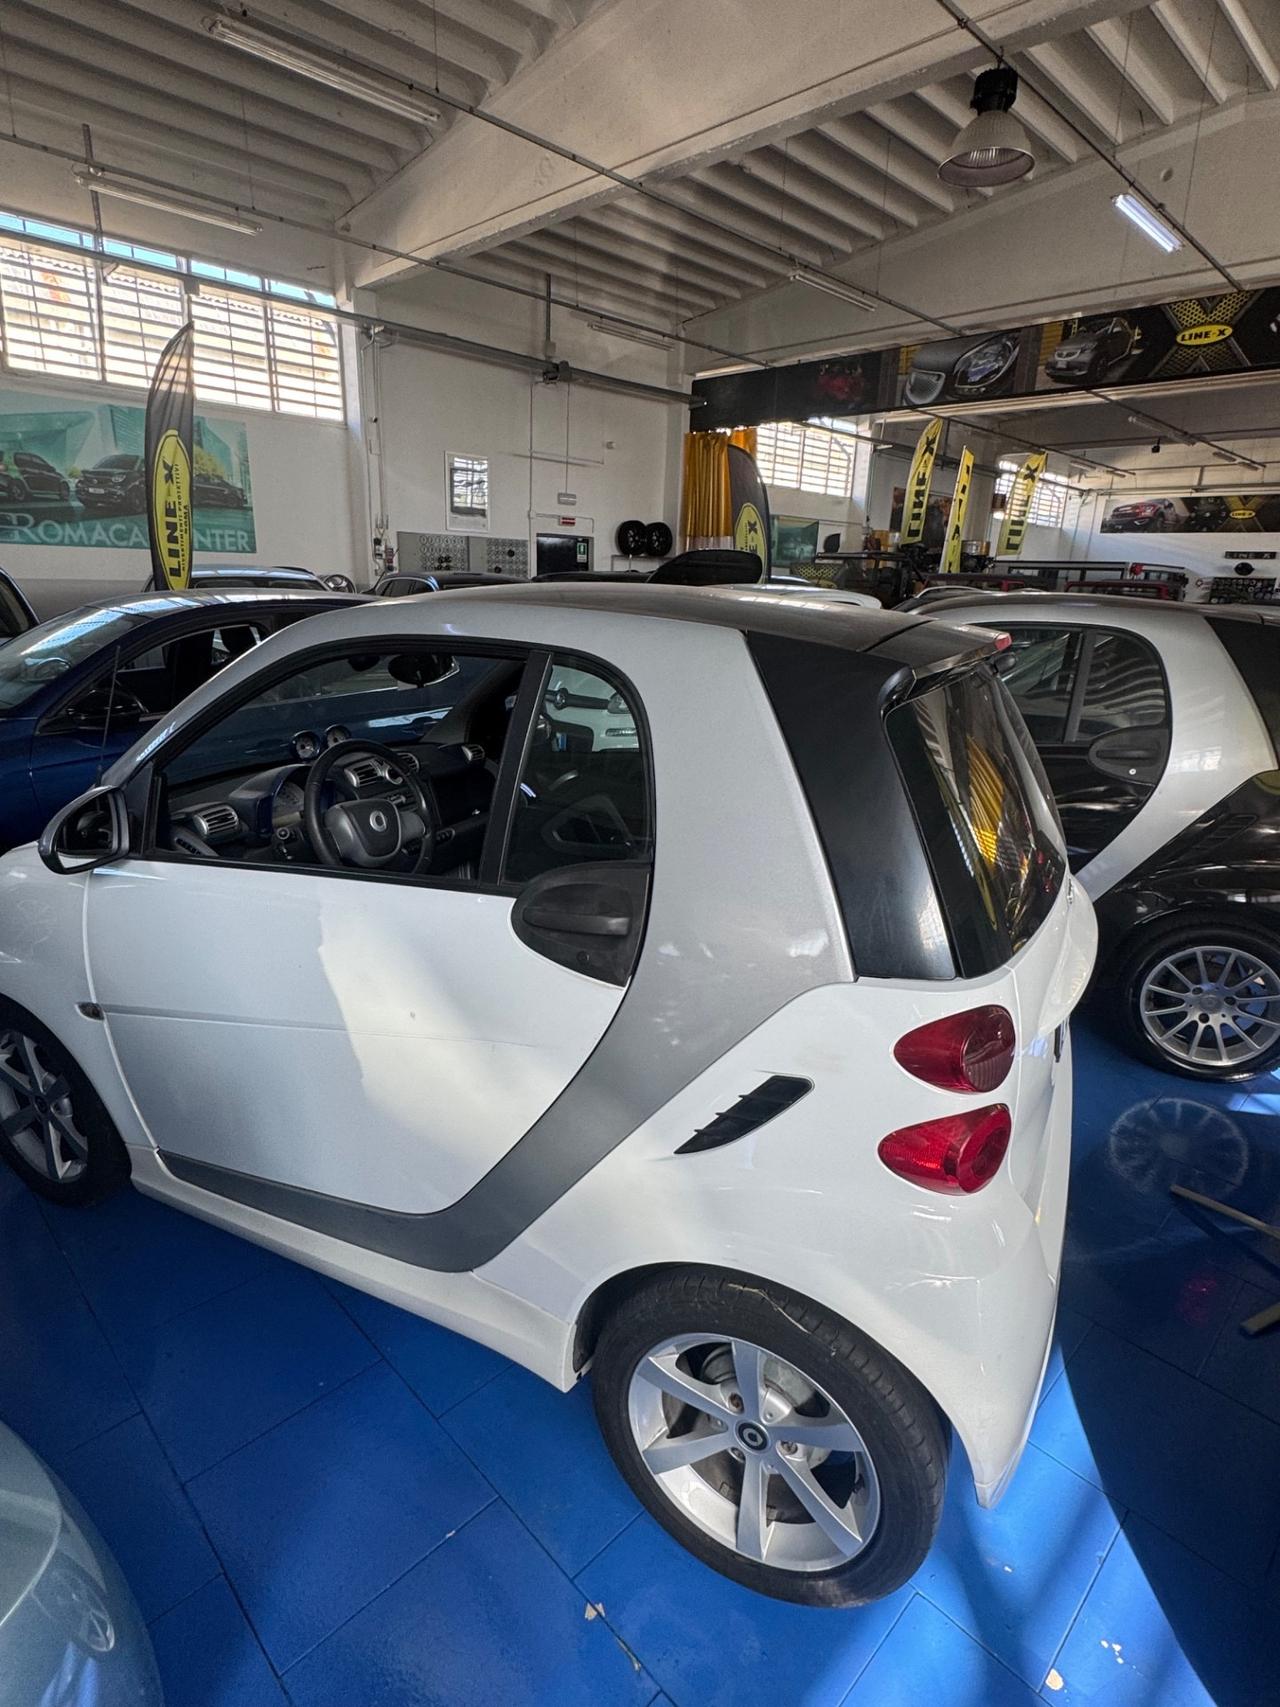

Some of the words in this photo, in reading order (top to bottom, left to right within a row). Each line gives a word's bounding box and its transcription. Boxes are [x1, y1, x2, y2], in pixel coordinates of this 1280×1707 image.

[1181, 328, 1229, 342] LINE-X
[162, 457, 182, 578] LINE-X
[907, 432, 937, 538] LINE-X
